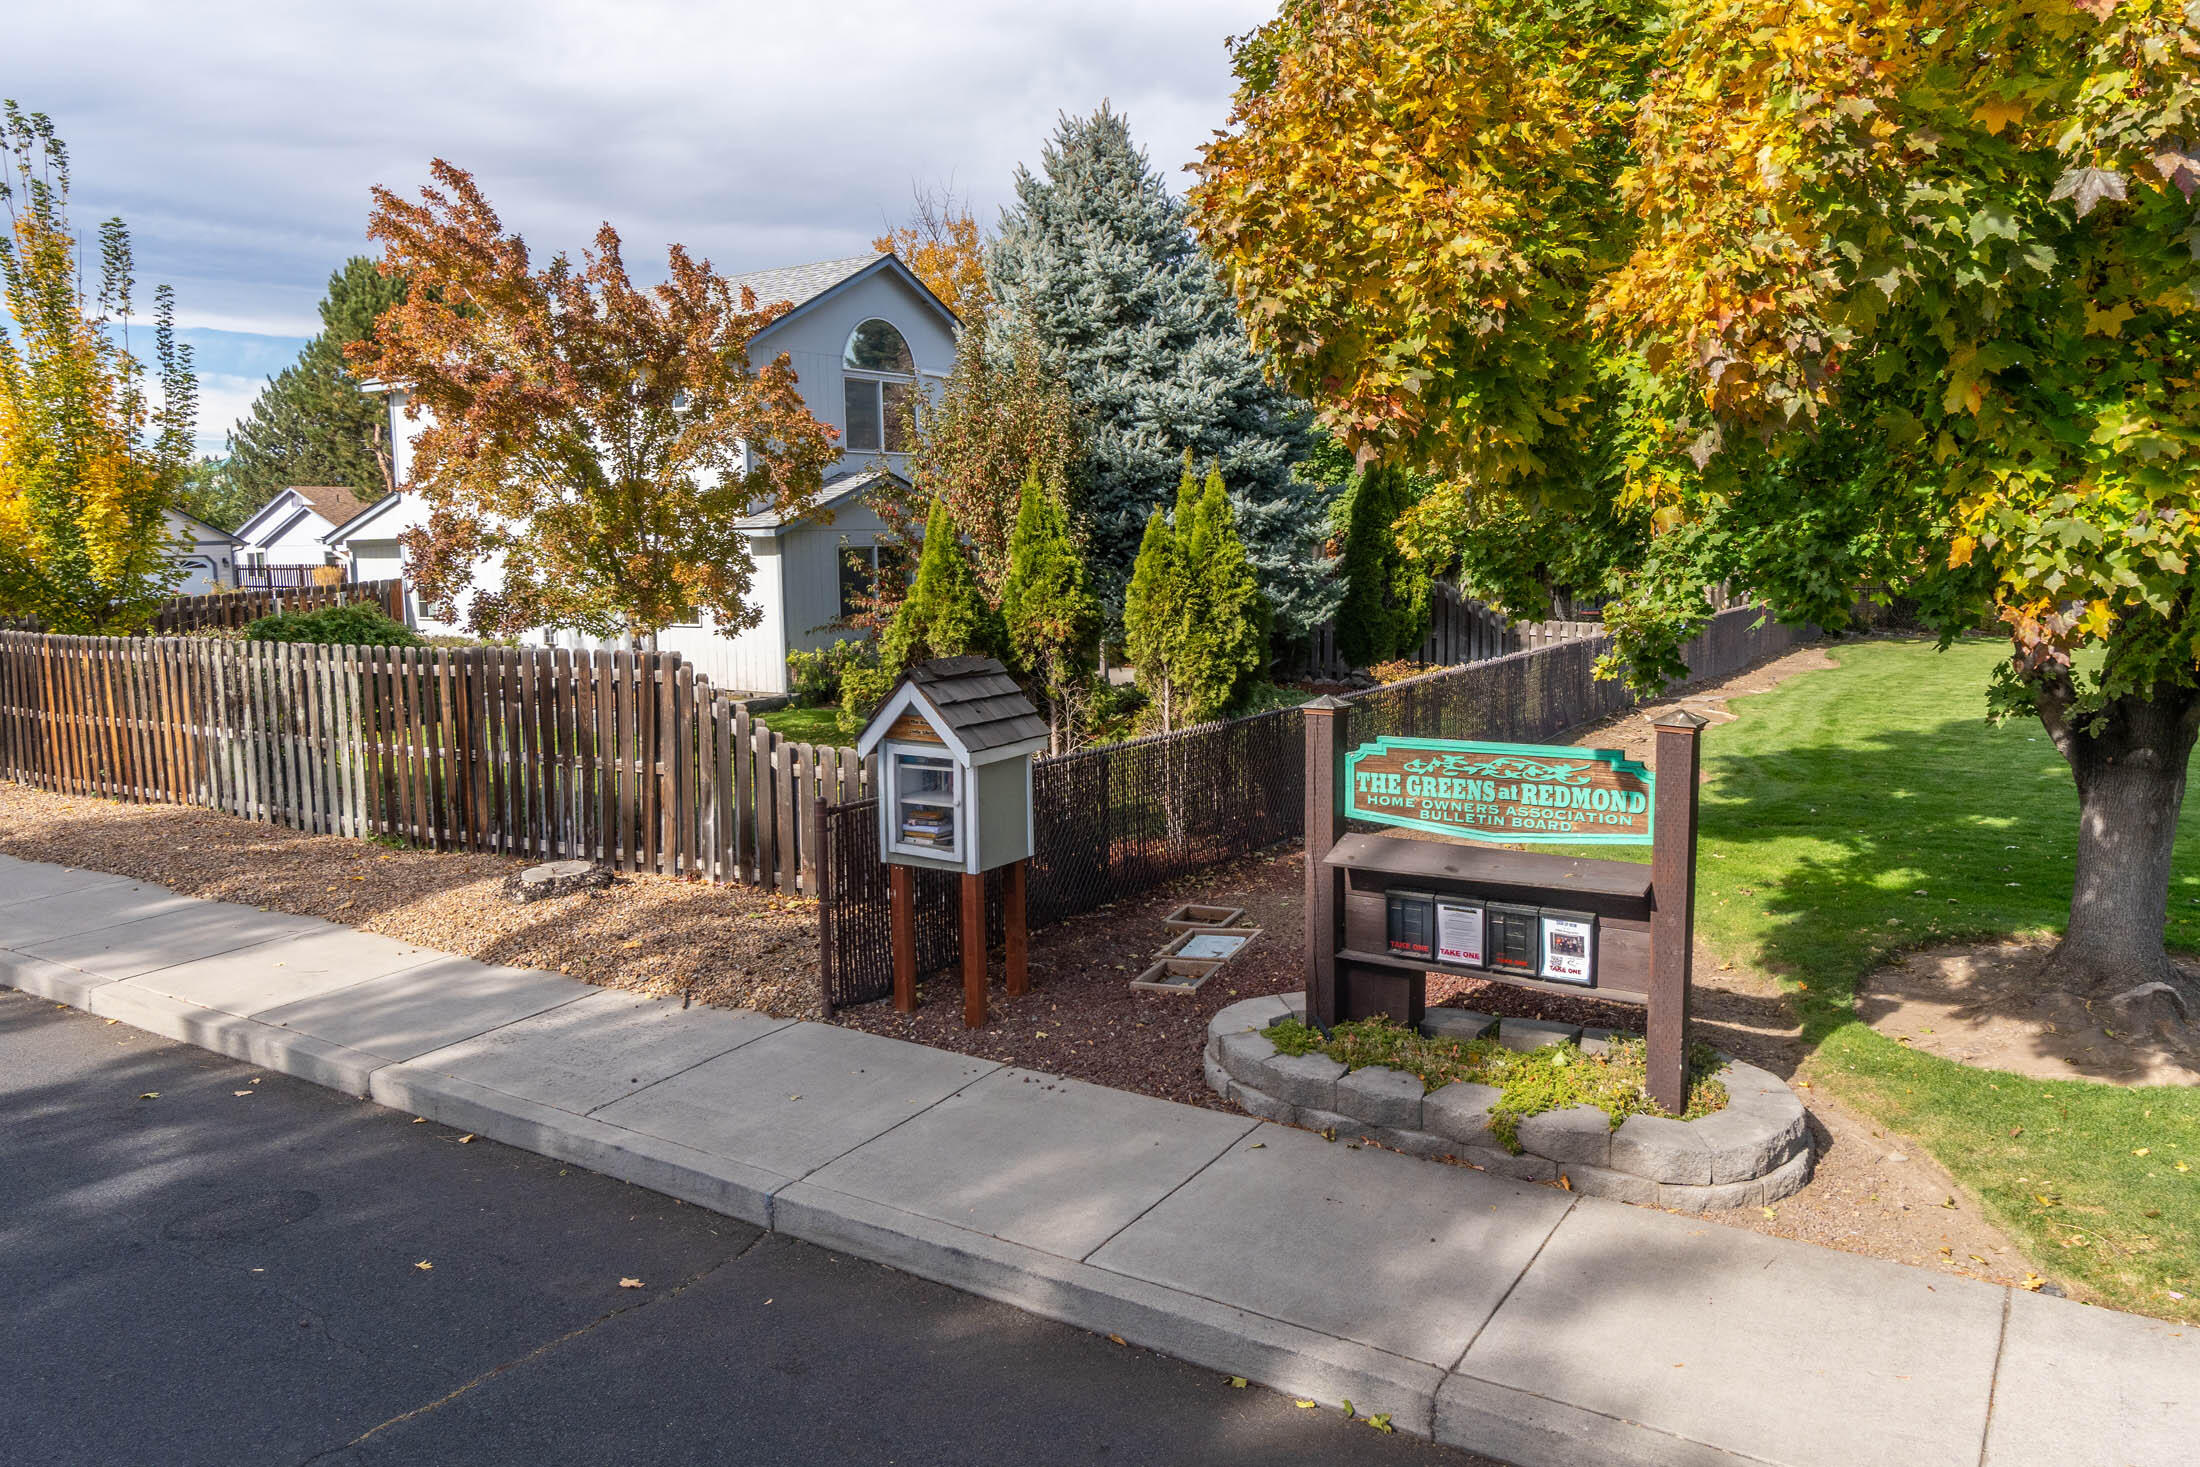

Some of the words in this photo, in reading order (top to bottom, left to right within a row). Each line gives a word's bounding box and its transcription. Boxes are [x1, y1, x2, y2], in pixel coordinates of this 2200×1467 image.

[1356, 771, 1401, 795] THE
[1406, 774, 1496, 803] GREENS
[1498, 785, 1520, 801] at
[1521, 783, 1646, 814] REDMOND
[1367, 794, 1415, 809] HOME
[1421, 799, 1499, 815] OWNERS
[1506, 805, 1633, 826] ASSOCIATION
[1420, 809, 1505, 826] BULLETIN
[1512, 818, 1572, 832] BOARD
[1390, 940, 1410, 949] TAKE
[1412, 943, 1429, 952] ONE
[1440, 948, 1461, 957] TAKE
[1462, 951, 1480, 960] ONE
[1550, 965, 1566, 973] TAKE
